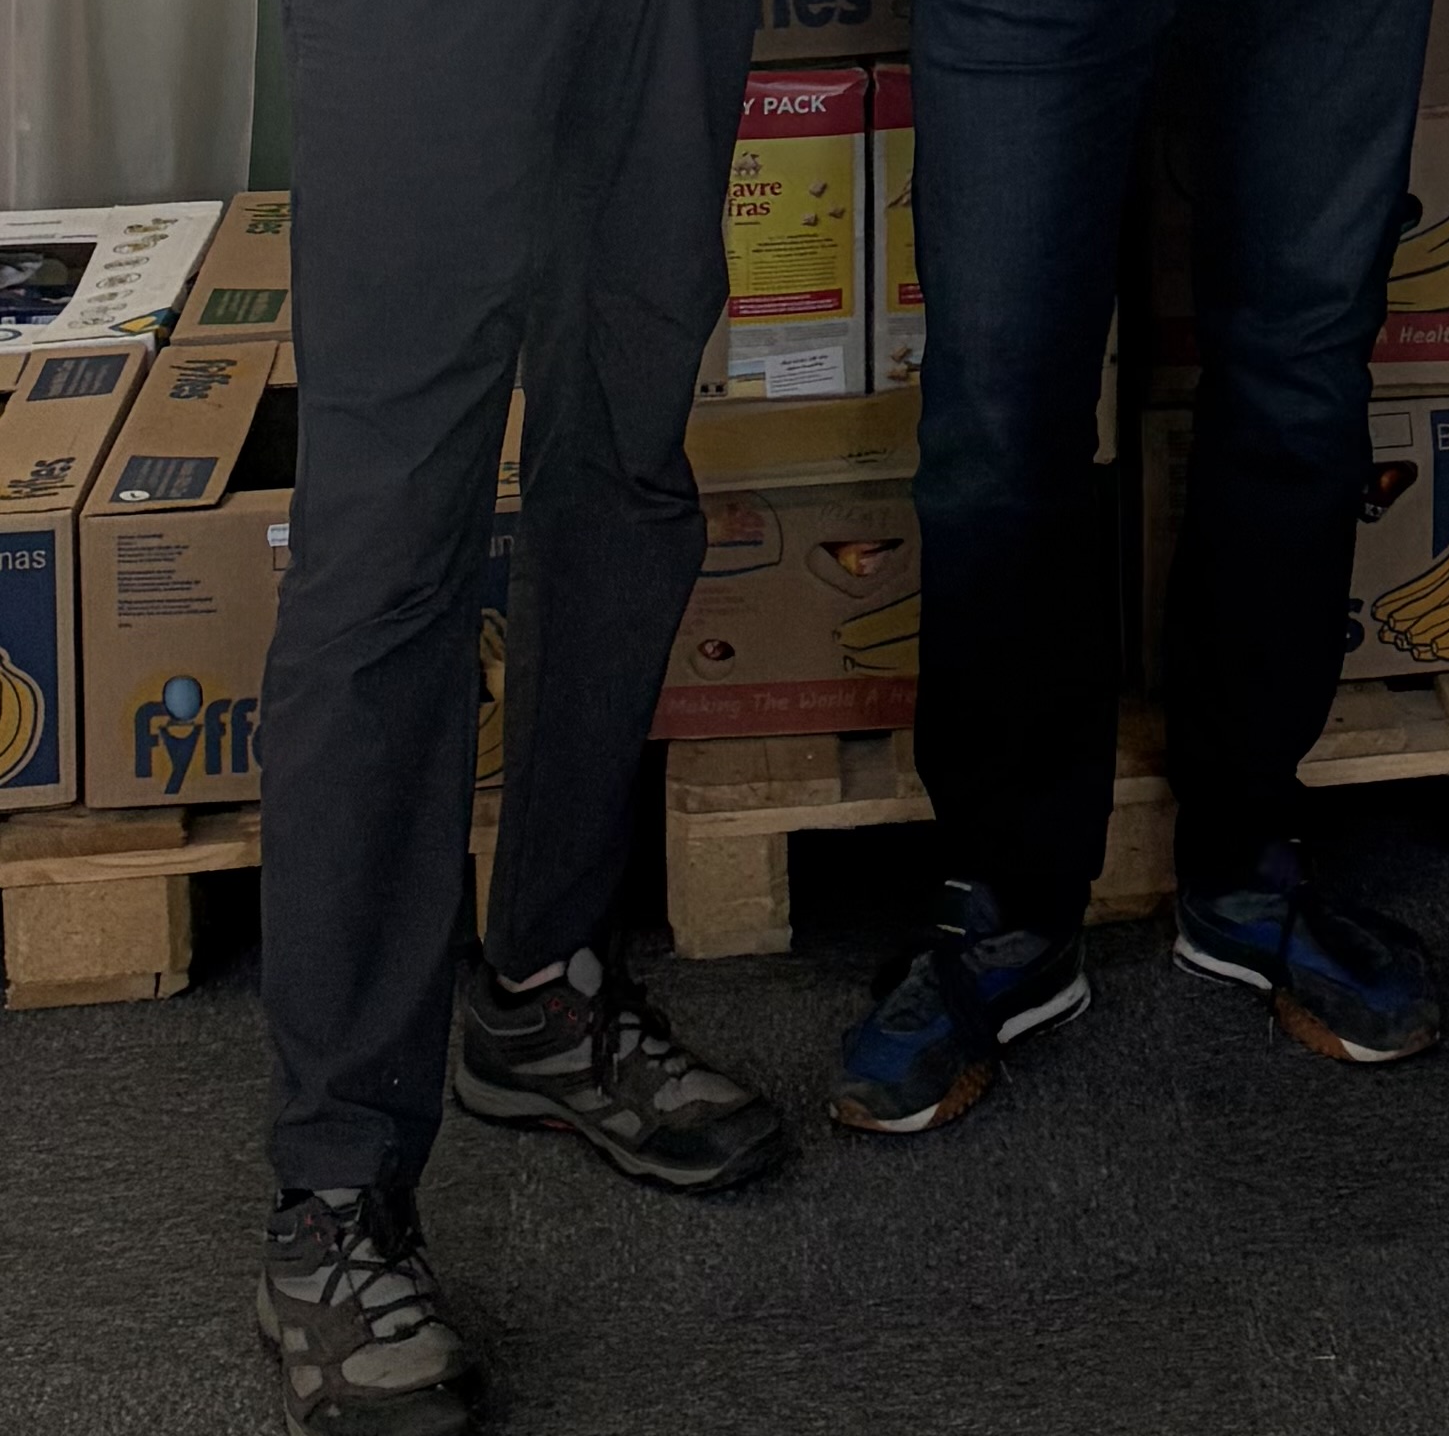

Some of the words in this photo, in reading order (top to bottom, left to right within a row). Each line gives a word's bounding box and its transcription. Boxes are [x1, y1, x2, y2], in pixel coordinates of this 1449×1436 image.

[763, 94, 828, 116] PACK
[728, 181, 782, 198] avre
[753, 692, 790, 711] The
[800, 690, 856, 710] World
